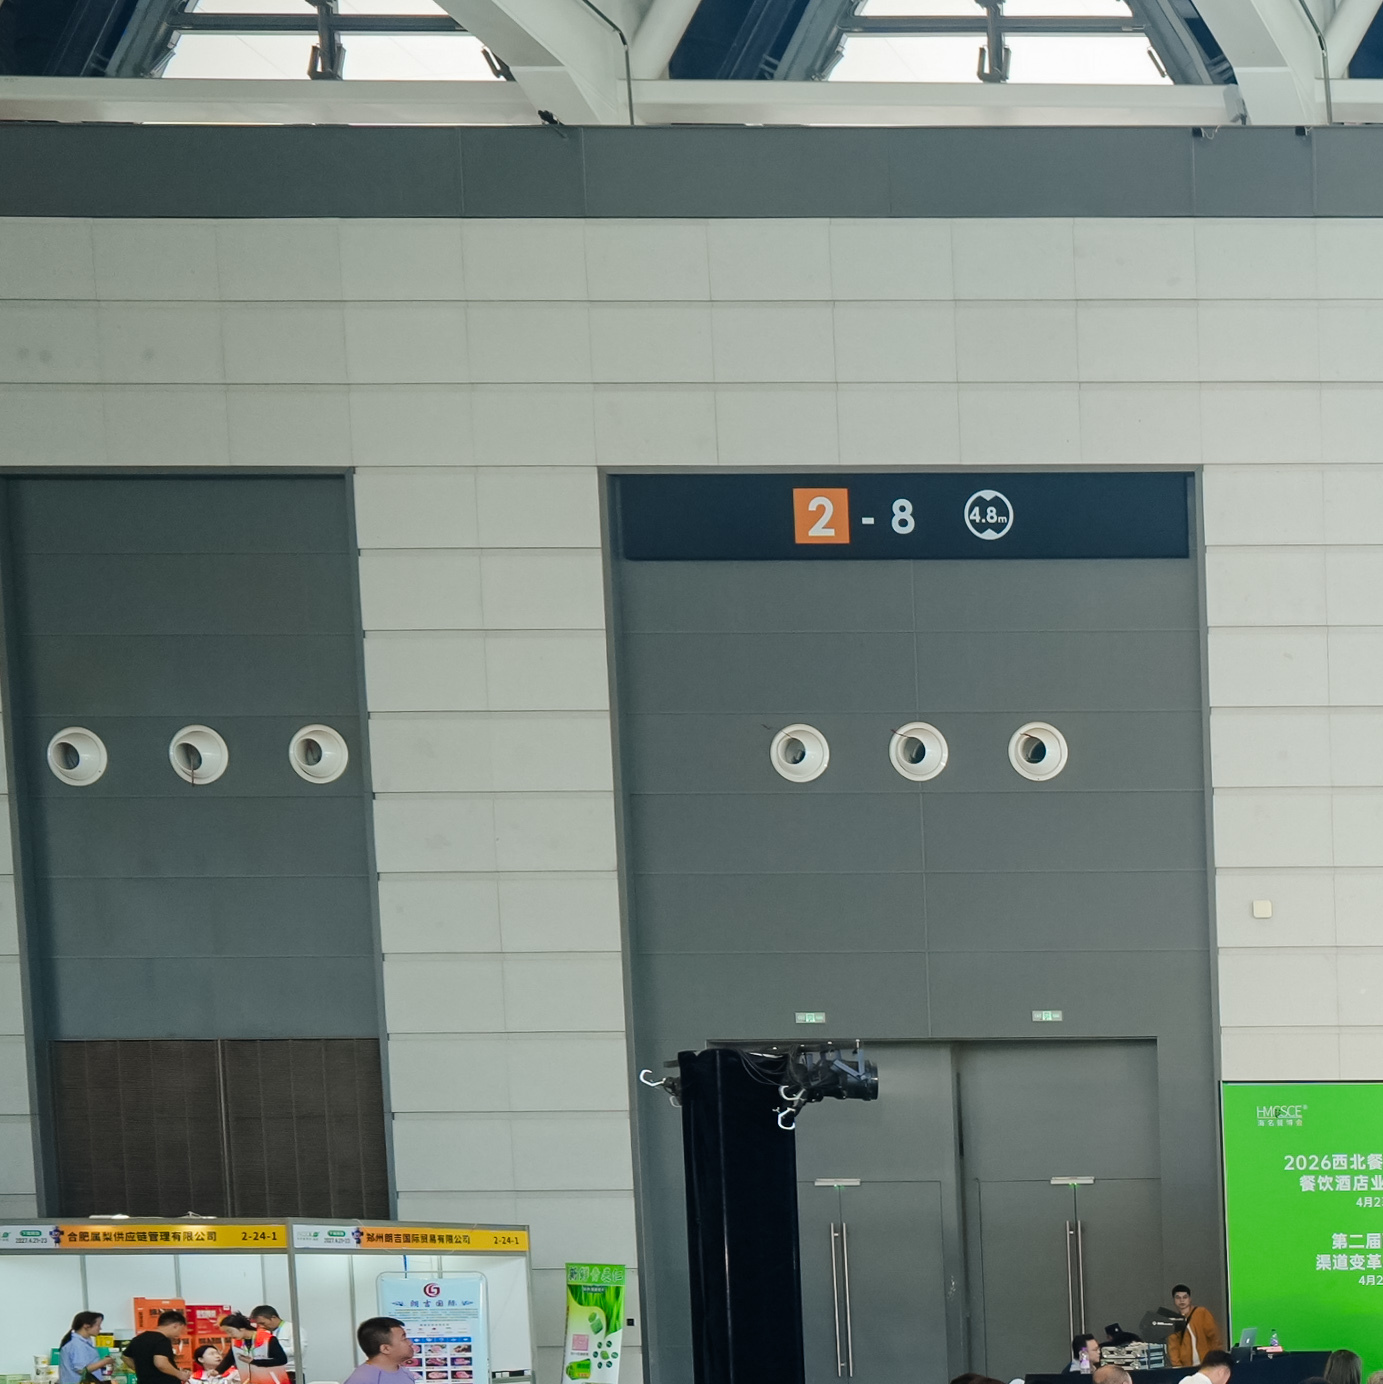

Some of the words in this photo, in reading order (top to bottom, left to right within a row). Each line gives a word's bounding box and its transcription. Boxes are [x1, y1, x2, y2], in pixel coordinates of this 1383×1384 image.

[807, 496, 836, 537] 2
[890, 498, 916, 535] 8
[969, 506, 1008, 526] 4.8m
[240, 1230, 278, 1242] 2-24-1
[366, 1232, 471, 1245] 郑州朗吉国际贸易有限公司
[493, 1236, 520, 1245] 2-24-1
